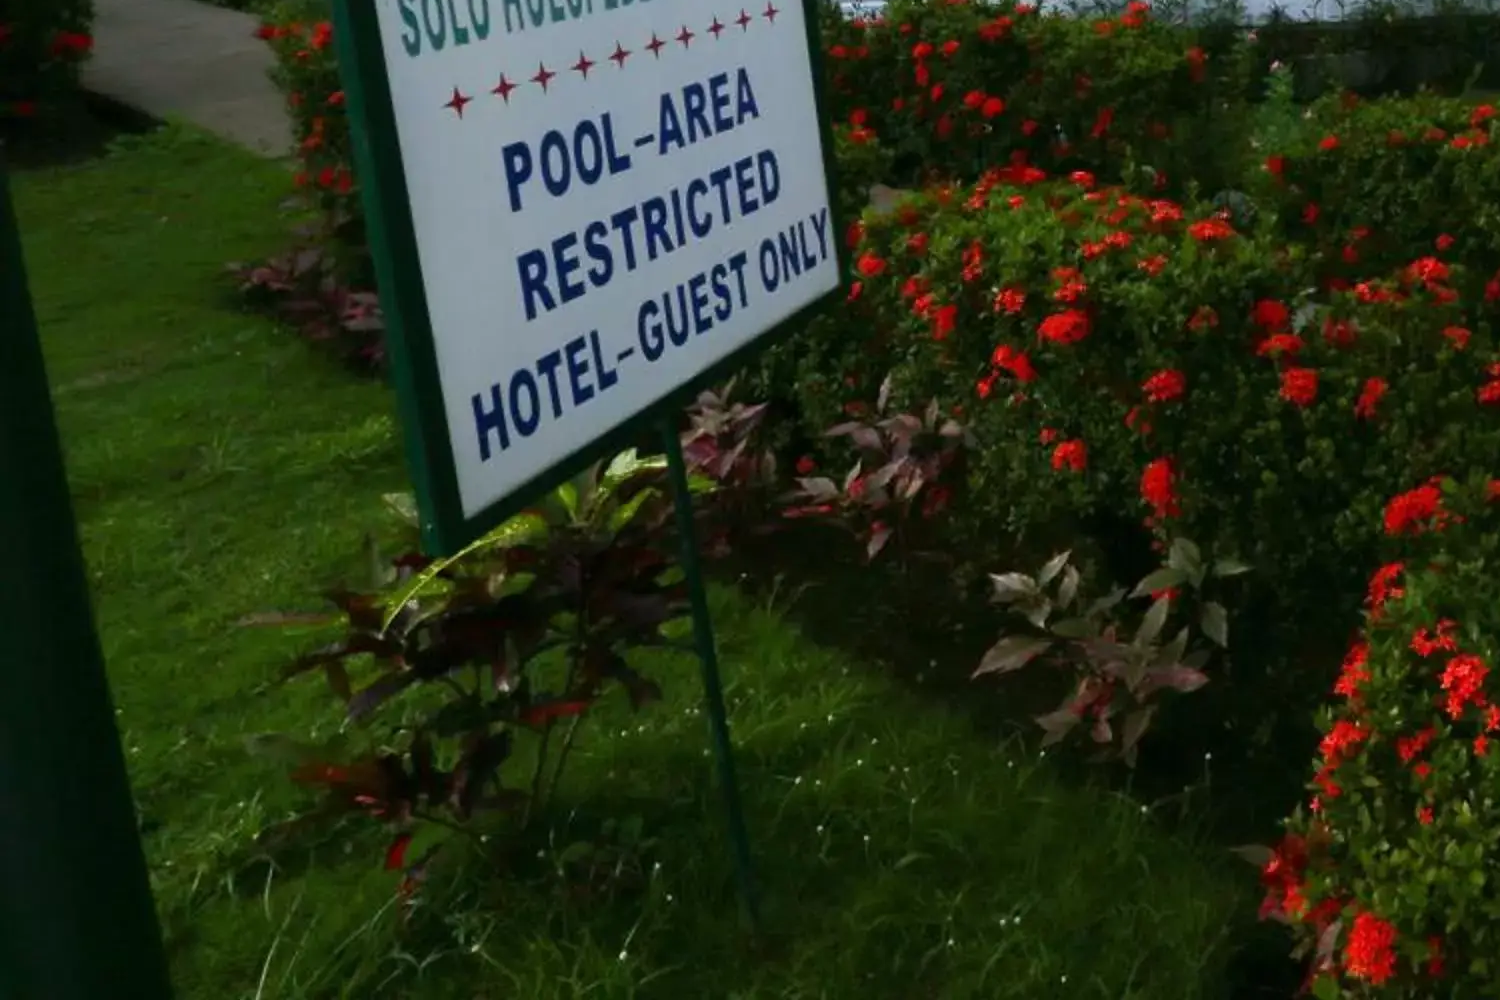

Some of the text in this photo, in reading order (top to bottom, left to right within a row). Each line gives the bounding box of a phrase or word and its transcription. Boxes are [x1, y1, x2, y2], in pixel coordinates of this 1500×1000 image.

[502, 67, 759, 212] POOL-AREA
[517, 149, 780, 321] RESTRICTED
[471, 207, 829, 462] HOTEL-GUEST ONLY
